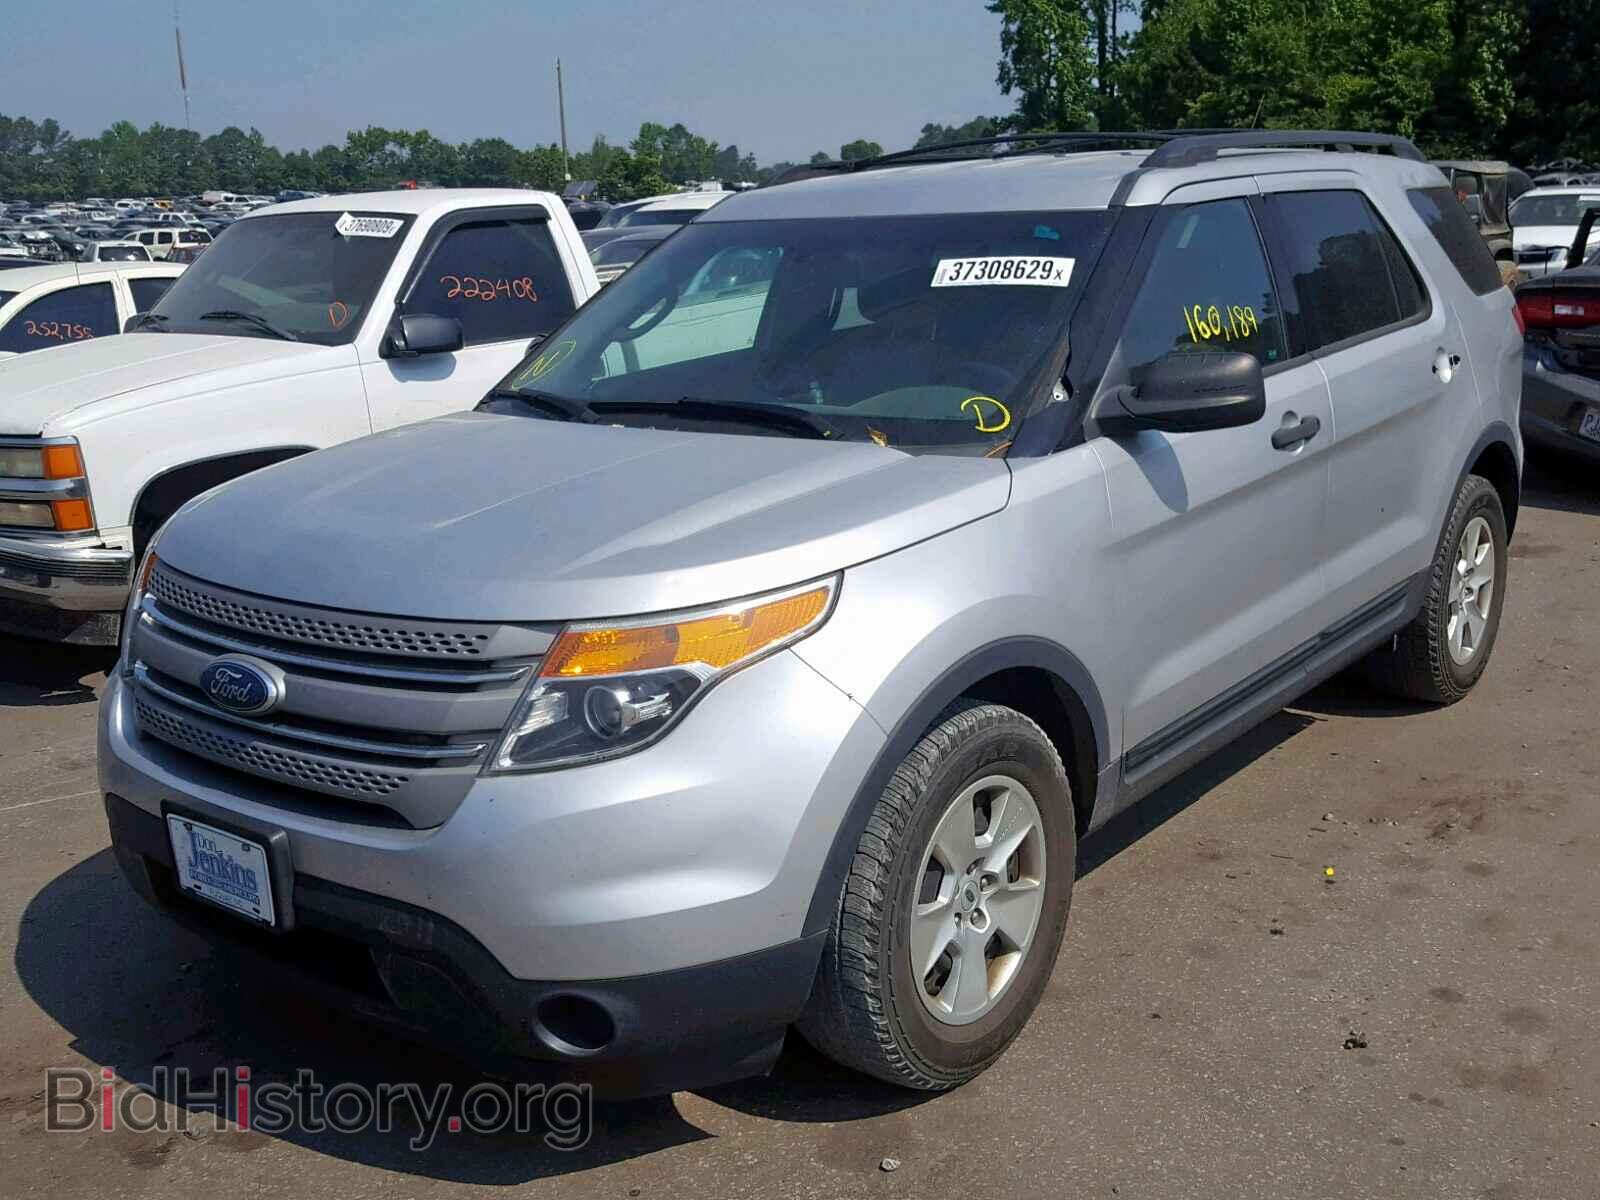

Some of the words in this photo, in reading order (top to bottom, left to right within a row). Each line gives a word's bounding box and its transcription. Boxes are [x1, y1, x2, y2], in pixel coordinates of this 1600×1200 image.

[440, 275, 537, 302] 222408
[329, 301, 347, 329] D
[1184, 304, 1258, 343] 160,189
[960, 396, 1010, 432] D
[210, 667, 253, 702] Ford
[188, 832, 258, 893] Jenkins
